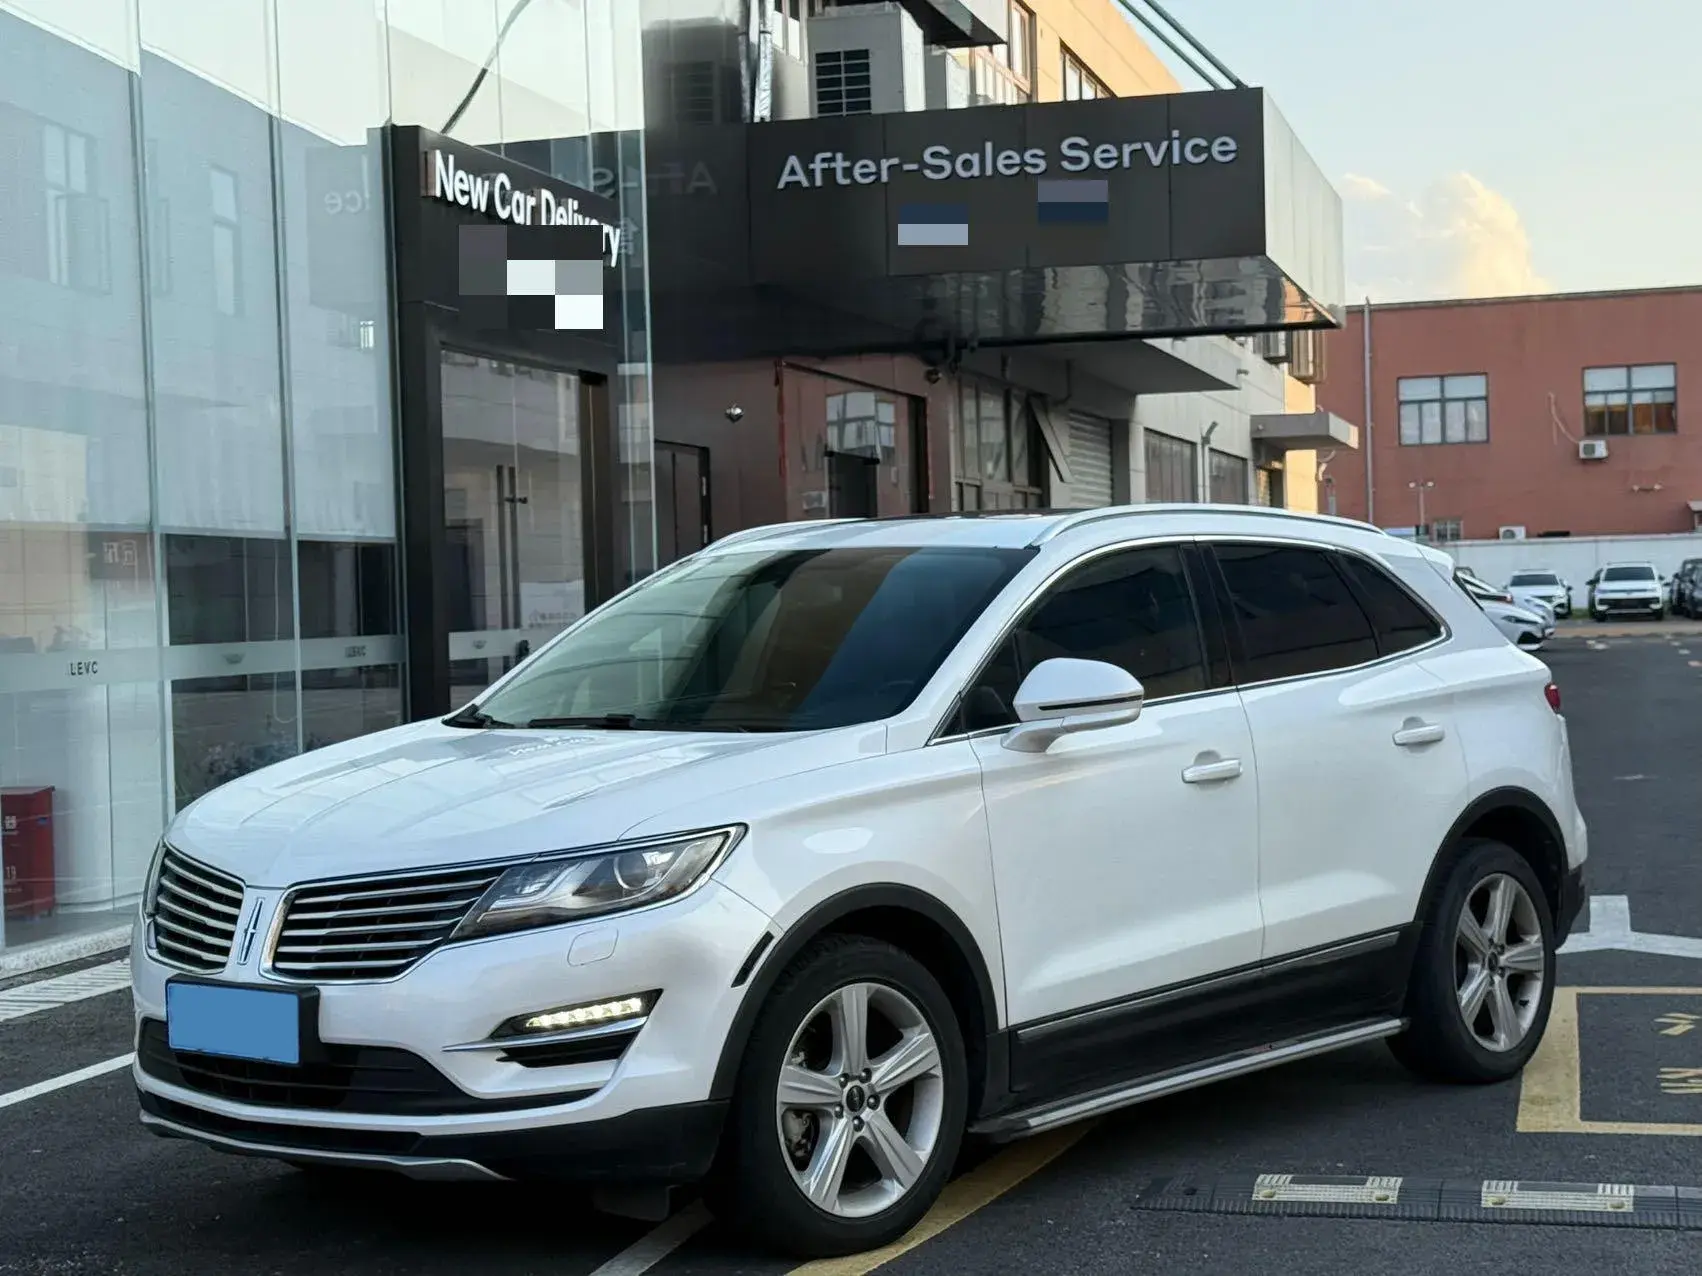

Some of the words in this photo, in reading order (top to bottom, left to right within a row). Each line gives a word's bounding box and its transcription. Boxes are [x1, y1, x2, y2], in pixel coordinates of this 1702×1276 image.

[435, 150, 489, 212] New
[494, 172, 536, 226] Car
[777, 141, 1047, 189] After-Sales
[1060, 129, 1237, 171] Service
[70, 660, 98, 676] LEVC
